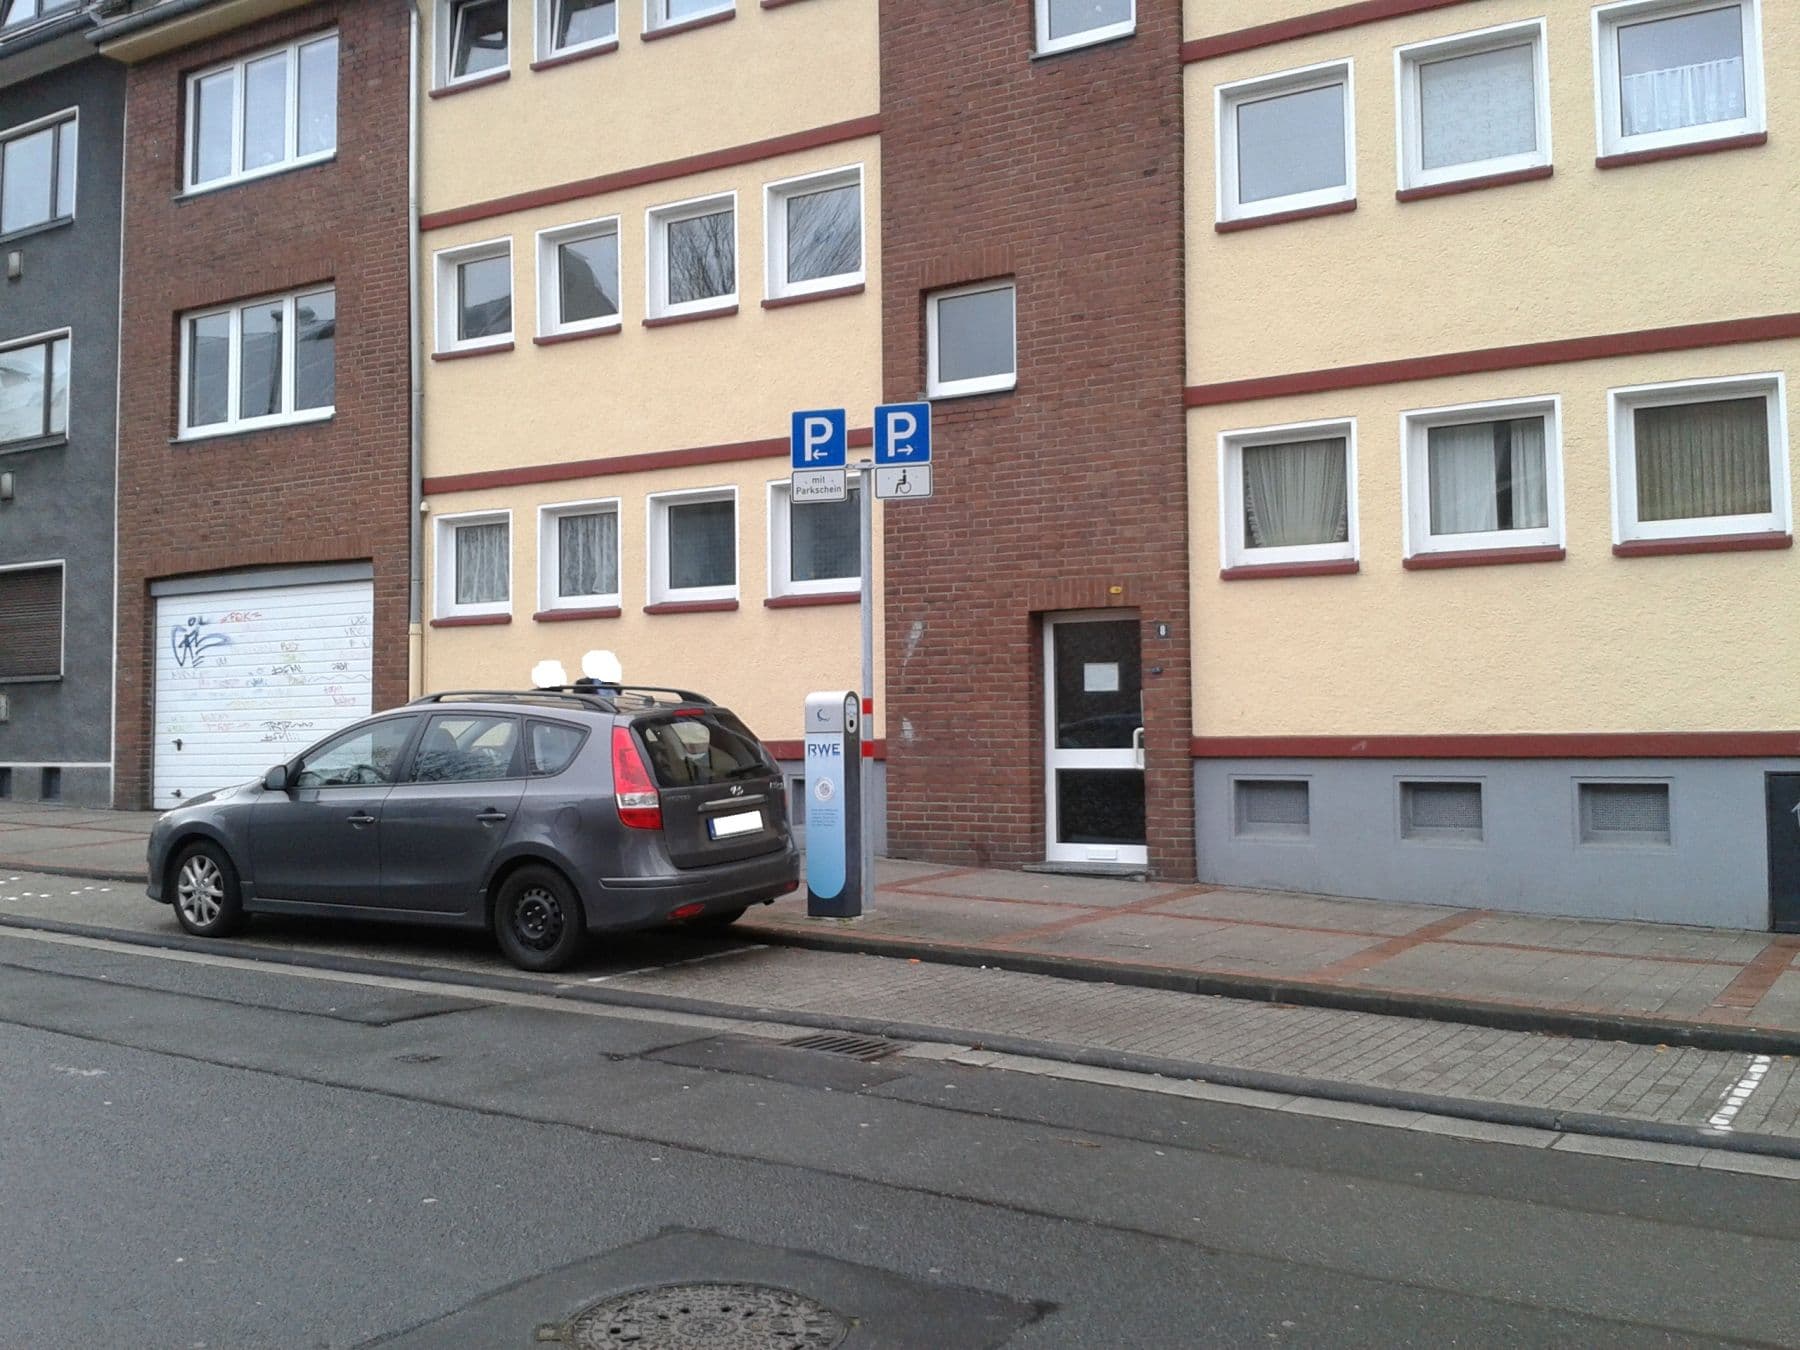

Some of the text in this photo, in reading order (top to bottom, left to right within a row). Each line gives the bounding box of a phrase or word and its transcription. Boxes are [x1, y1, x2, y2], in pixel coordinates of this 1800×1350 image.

[804, 417, 833, 461] P
[887, 411, 917, 457] P
[811, 476, 826, 484] mit
[795, 486, 842, 495] Parkschein
[807, 743, 841, 757] RWE
